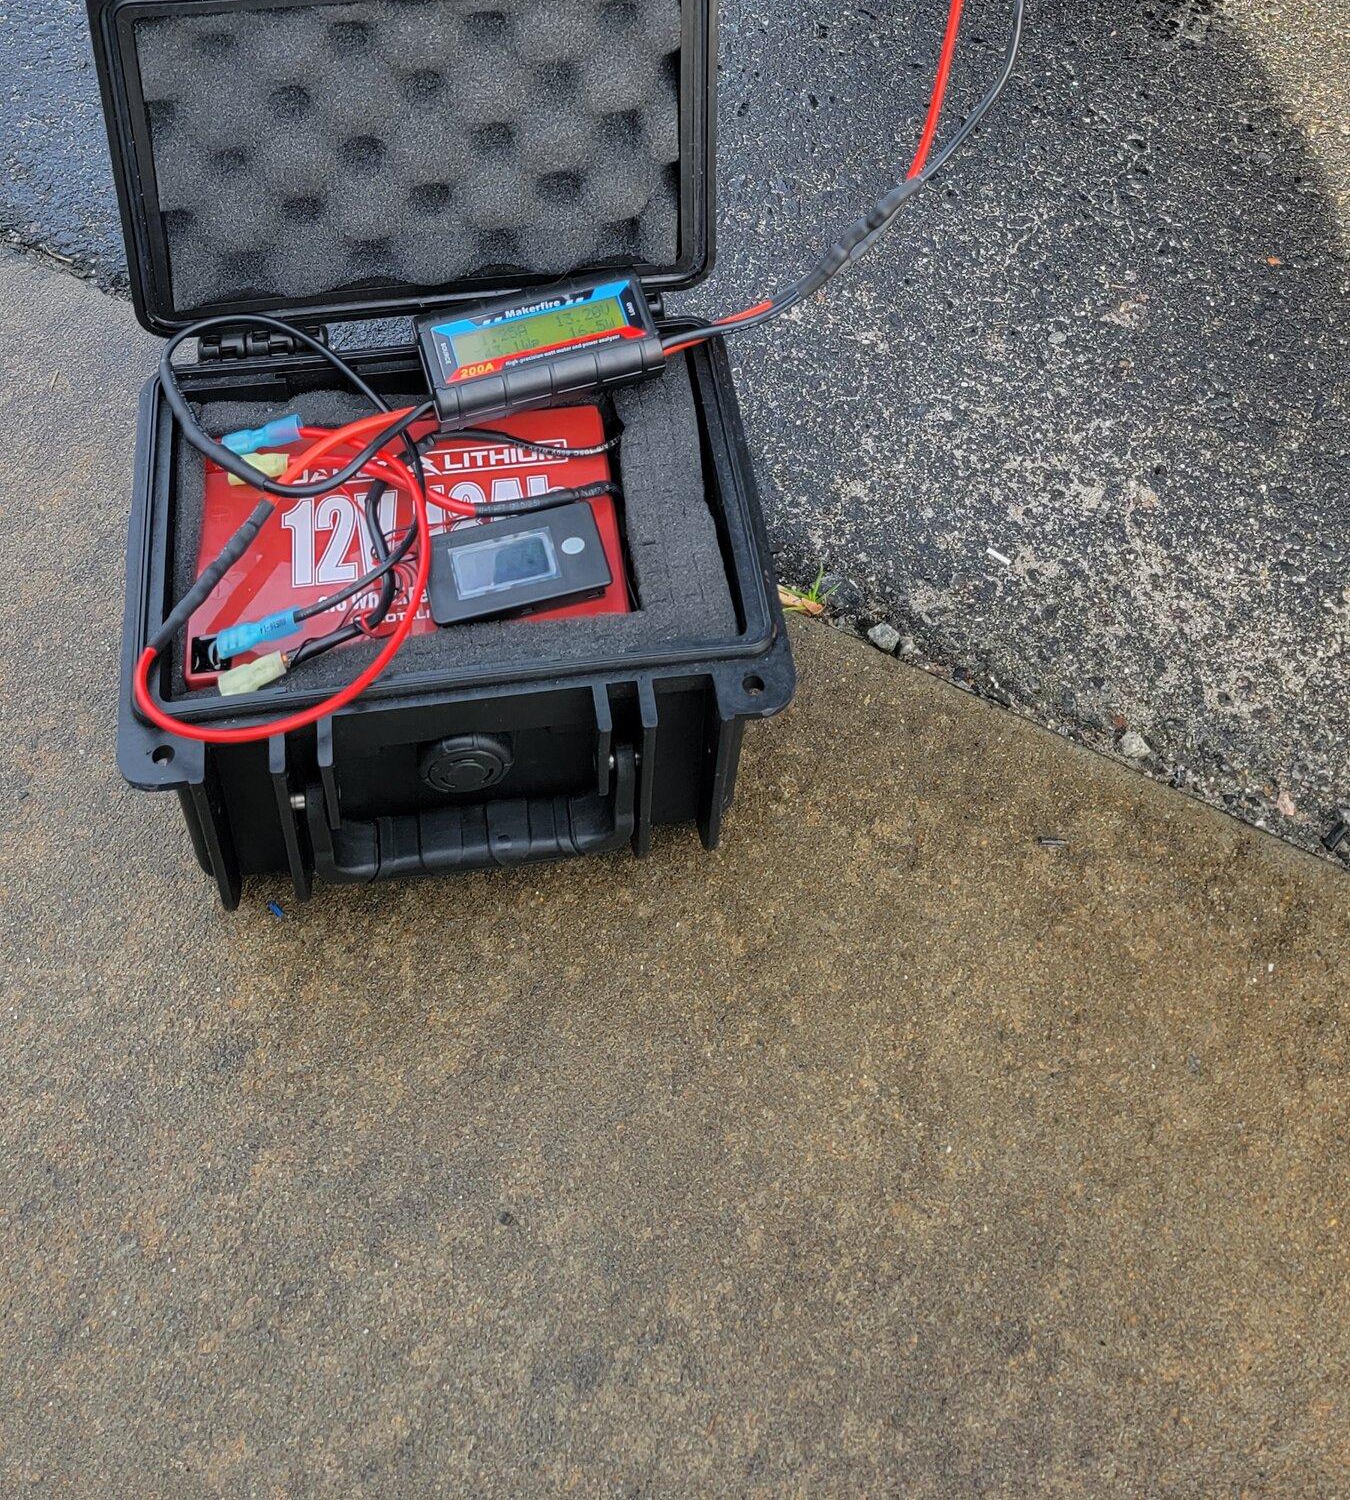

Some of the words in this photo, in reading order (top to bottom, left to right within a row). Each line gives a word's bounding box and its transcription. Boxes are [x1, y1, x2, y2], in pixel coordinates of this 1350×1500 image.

[505, 300, 561, 319] Makerfire
[460, 362, 495, 379] 200A
[281, 488, 398, 588] 12V
